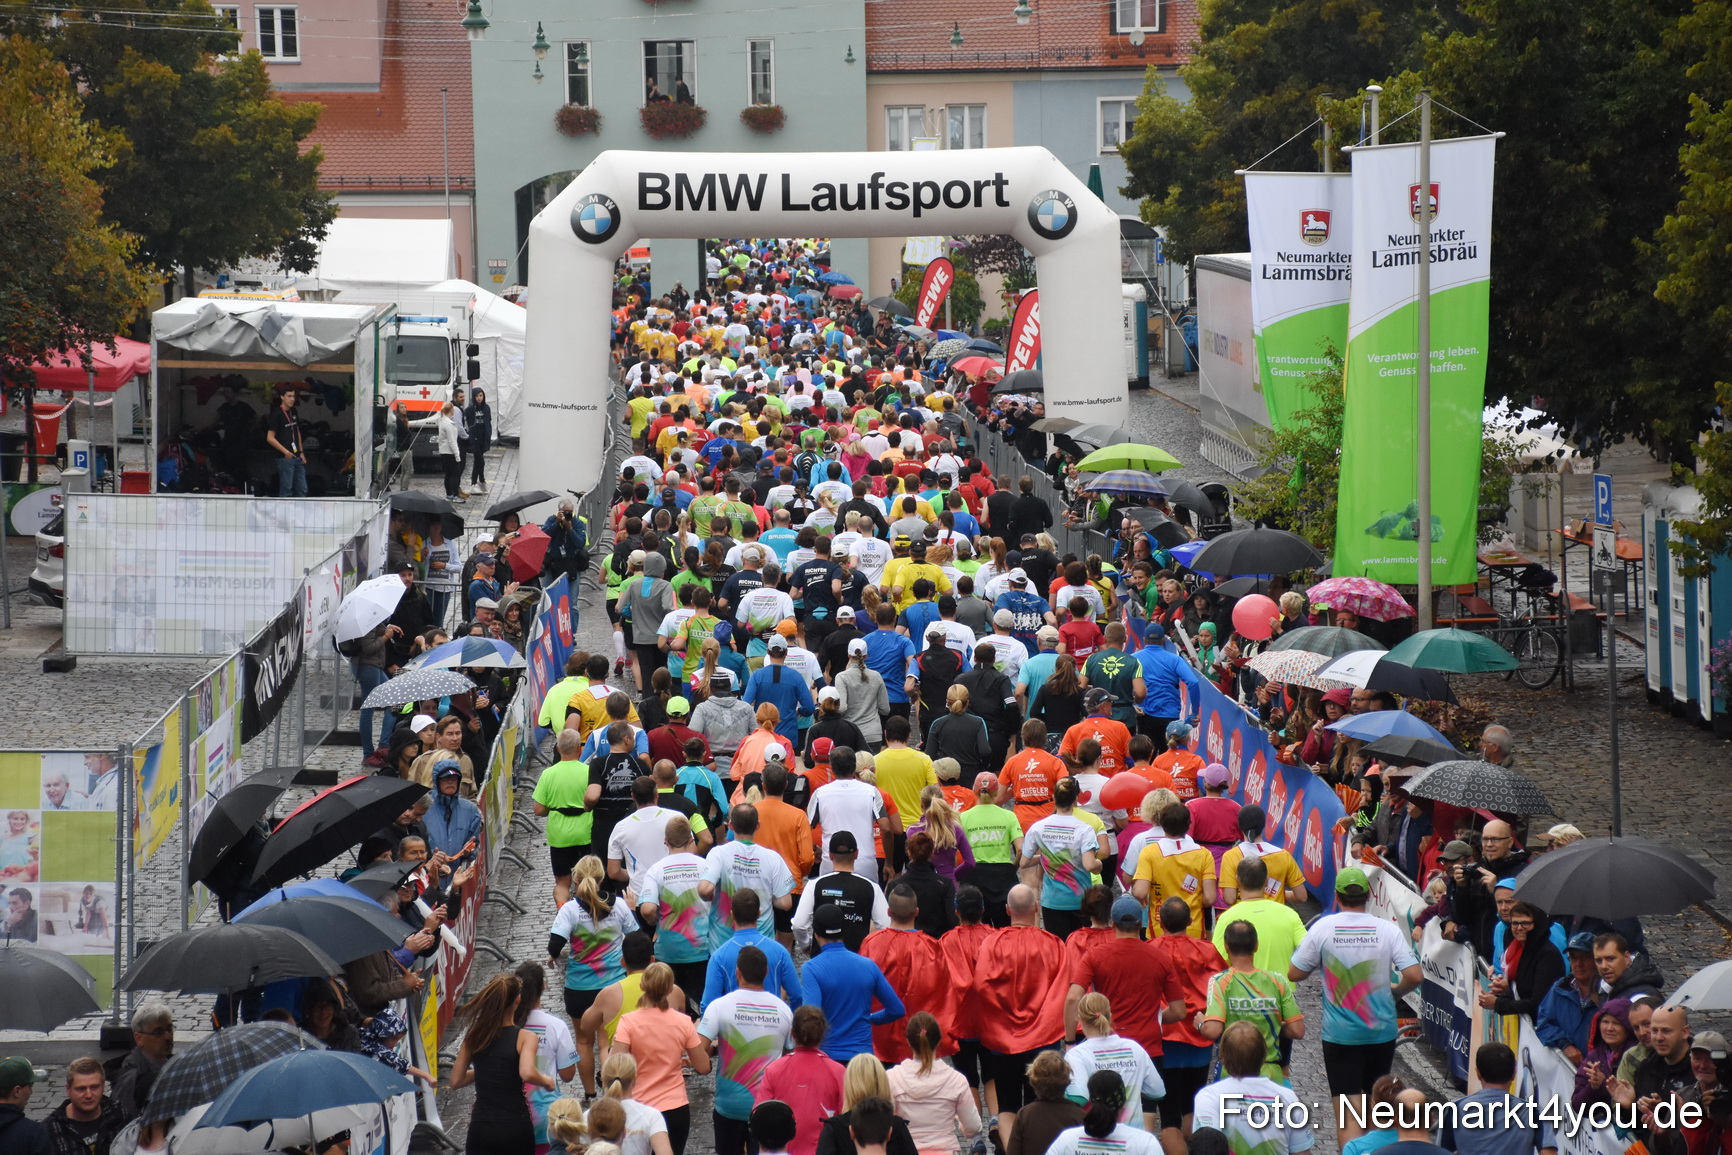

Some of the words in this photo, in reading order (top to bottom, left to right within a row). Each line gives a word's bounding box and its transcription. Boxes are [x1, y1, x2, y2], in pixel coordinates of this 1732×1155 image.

[638, 172, 768, 211] BMW
[781, 172, 1010, 218] Laufsport
[1034, 190, 1075, 209] BMW
[574, 194, 616, 212] BMW
[1277, 251, 1352, 263] Neumarkter
[1263, 264, 1352, 281] Lammsbrä
[917, 266, 949, 328] REWE
[1367, 349, 1445, 363] Verantworung
[1448, 346, 1479, 357] leben.
[1266, 355, 1333, 366] erantwortung
[1271, 367, 1306, 377] Genuss
[1379, 367, 1416, 377] Genuss
[1430, 362, 1467, 373] haffen.
[528, 401, 598, 411] www.bmw-laufsport.de
[1053, 396, 1122, 406] www.bmw-laufsport.de
[77, 454, 85, 466] P
[1598, 481, 1608, 518] P
[1361, 556, 1447, 566] www.lammsbru.de
[1020, 787, 1049, 795] STIEGLER
[980, 831, 1007, 841] DAV
[1041, 833, 1075, 842] NeuerMarkt
[663, 872, 700, 881] NeuerMarkt
[1333, 936, 1379, 944] NeuerMarkt
[1228, 997, 1279, 1010] BOCK
[734, 1013, 781, 1024] NeuerMarkt
[1095, 1060, 1138, 1070] NeuerMarkt
